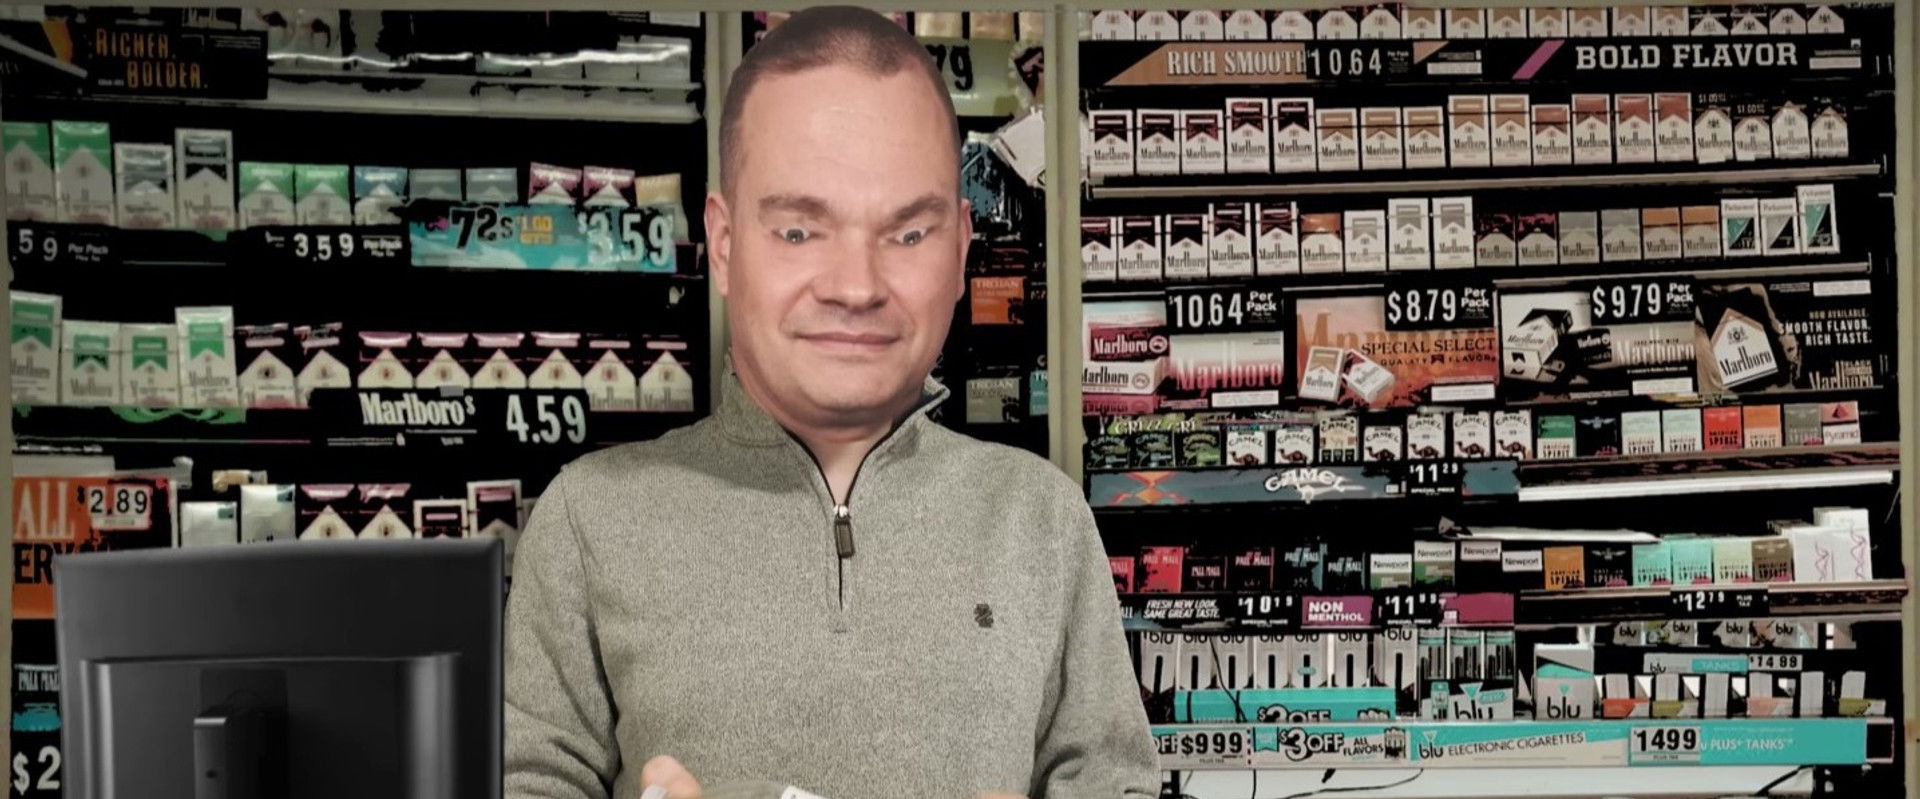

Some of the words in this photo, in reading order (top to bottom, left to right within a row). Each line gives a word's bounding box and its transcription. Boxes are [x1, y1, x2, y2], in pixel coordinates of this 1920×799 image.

[1167, 51, 1217, 75] RICH
[1225, 50, 1307, 75] SMOOTH
[1575, 45, 1661, 70] BOLD
[1672, 42, 1798, 68] FLAVOR
[293, 232, 354, 262] 3.59
[1083, 254, 1115, 269] arlboro
[1464, 287, 1486, 297] Per
[1669, 283, 1690, 293] Per
[1250, 291, 1273, 302] Per
[1461, 297, 1489, 308] Pack
[1592, 283, 1661, 318] $9.79
[1666, 292, 1693, 303] Pack
[1246, 301, 1277, 312] Pack
[1388, 290, 1456, 324] $8.79
[1779, 321, 1823, 334] SMOOTH
[1827, 318, 1872, 332] FLAVOR.
[1094, 334, 1148, 354] Marlboro
[1805, 333, 1831, 346] RICH
[1836, 331, 1873, 344] TASTE.
[1361, 341, 1430, 356] SPECIAL
[1434, 337, 1496, 351] SELECT
[1615, 328, 1695, 368] Marlboro
[1176, 340, 1283, 391] Marlboro
[1720, 346, 1773, 376] Marlboro
[358, 392, 465, 425] Marlboro
[506, 394, 587, 444] 4.59
[1409, 419, 1442, 430] CAMEL
[1454, 416, 1487, 428] CAMEL
[1496, 414, 1528, 427] CAMEL
[1321, 420, 1354, 433] CAMEL
[1229, 436, 1263, 447] CAMEL
[1277, 433, 1312, 444] CAMEL
[1366, 432, 1399, 443] CAMEL
[1824, 429, 1859, 441] Pyramid
[1264, 467, 1346, 492] CAMEL
[1418, 548, 1452, 558] Newport
[1464, 546, 1498, 556] Newport
[1373, 559, 1409, 569] Newport
[1505, 557, 1539, 567] Newport
[1146, 600, 1172, 608] FRESH
[1174, 600, 1194, 608] NEW
[1309, 601, 1343, 612] NON
[1143, 609, 1167, 618] SAME
[1167, 609, 1194, 618] GREAT
[1308, 613, 1364, 622] MENTHOL
[1619, 625, 1637, 638] blu
[1673, 621, 1690, 634] blu
[1726, 621, 1743, 634] blu
[1775, 622, 1793, 635] blu
[1454, 699, 1493, 720] blu
[1546, 696, 1580, 719] blu
[1353, 737, 1368, 745] ALL
[1419, 742, 1444, 759] blu
[1449, 742, 1514, 756] ELECTRONIC
[1517, 732, 1584, 749] CIGARETTES
[1344, 743, 1384, 756] FLAVORS
